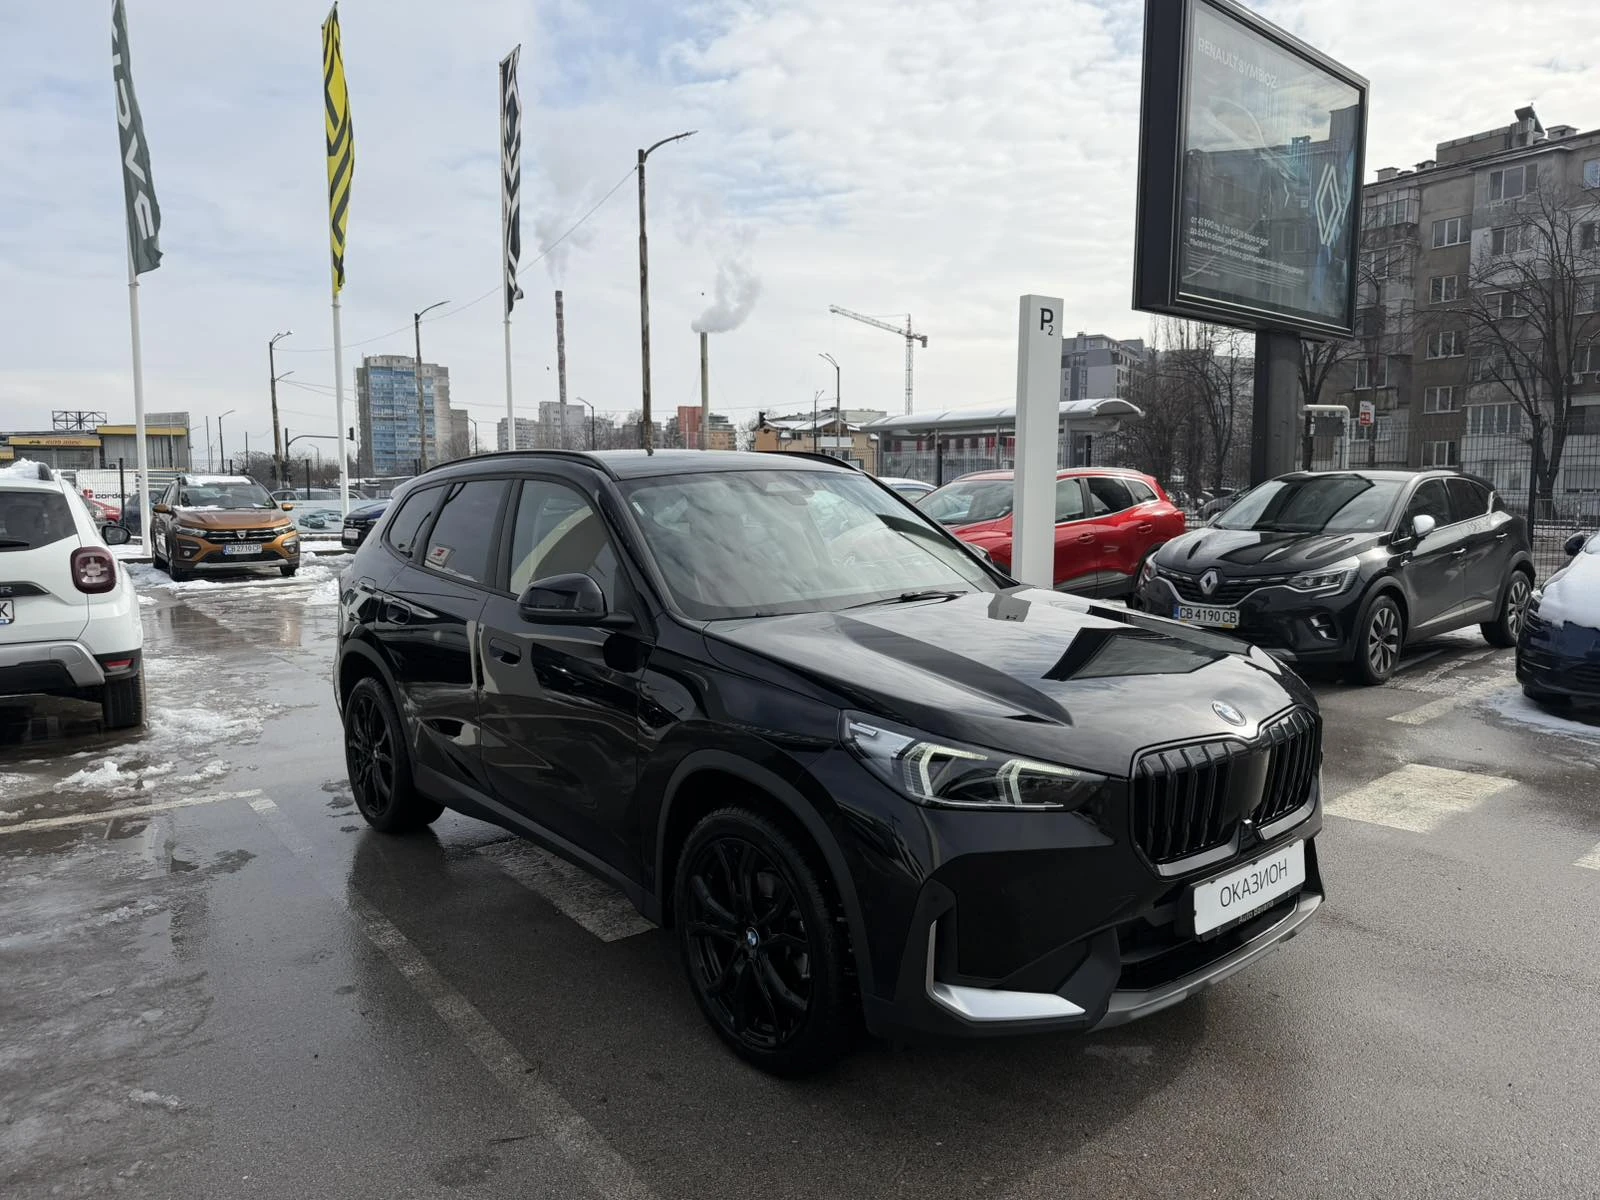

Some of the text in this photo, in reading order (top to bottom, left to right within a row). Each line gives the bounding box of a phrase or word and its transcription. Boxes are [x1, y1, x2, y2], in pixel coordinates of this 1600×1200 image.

[1198, 37, 1239, 70] RENAULT
[1179, 607, 1237, 624] CB 4190 CB
[1219, 858, 1289, 907] ОКАЗИОН
